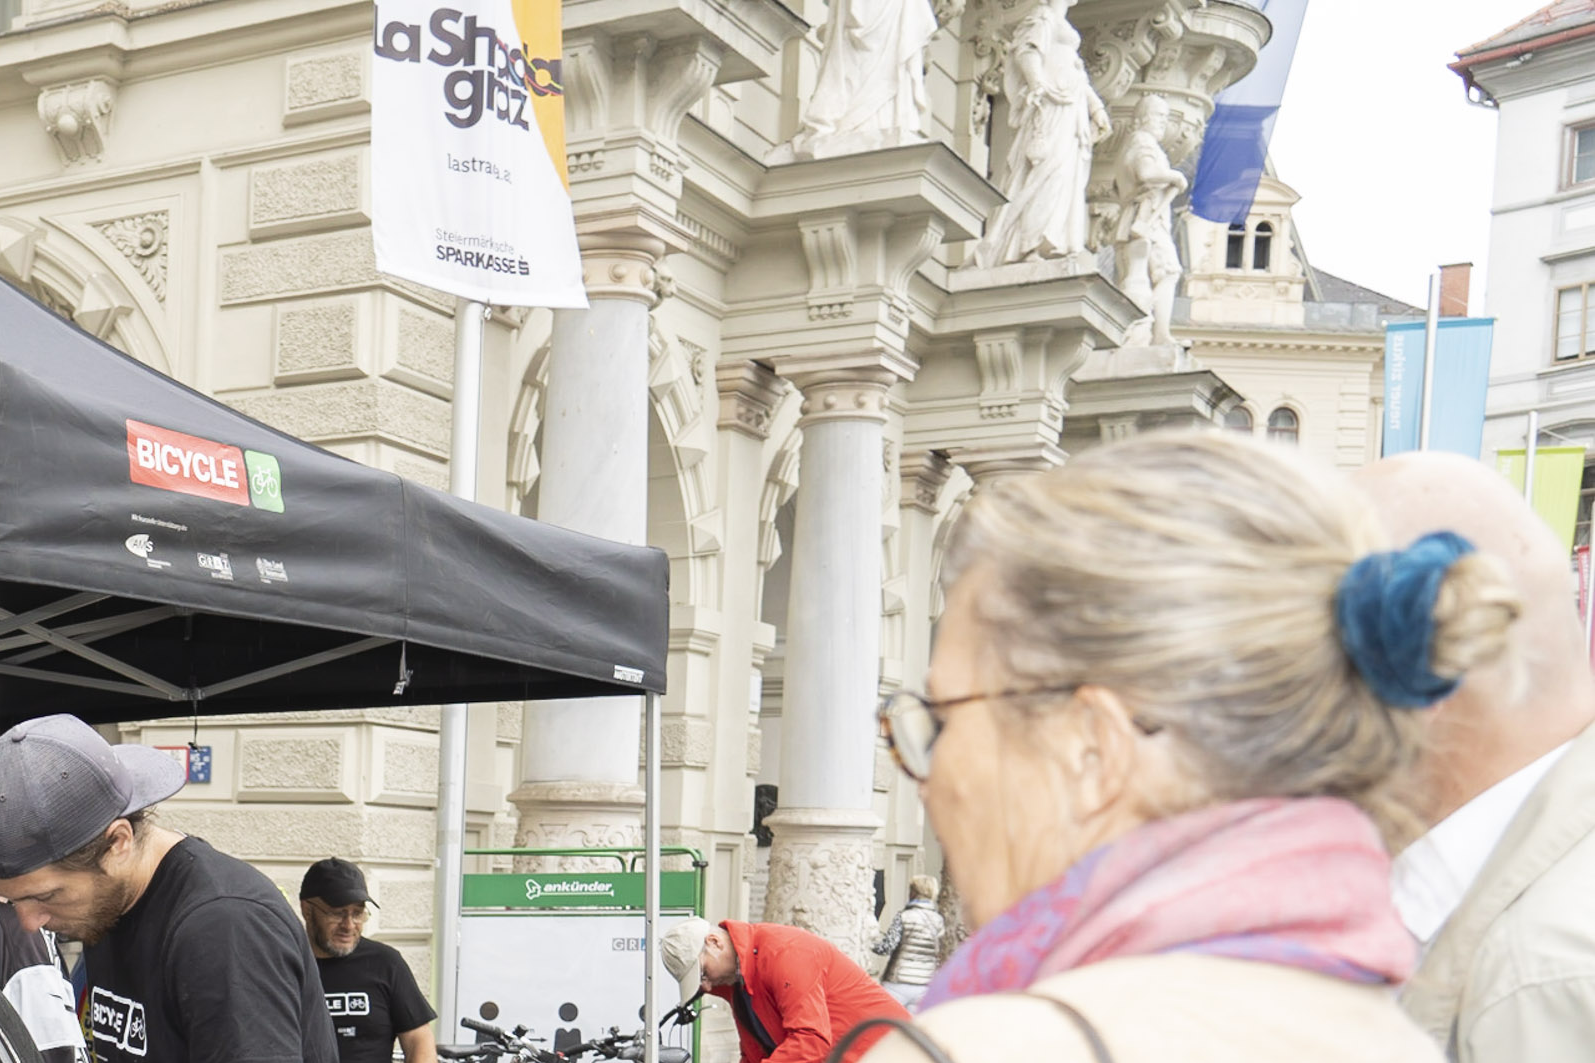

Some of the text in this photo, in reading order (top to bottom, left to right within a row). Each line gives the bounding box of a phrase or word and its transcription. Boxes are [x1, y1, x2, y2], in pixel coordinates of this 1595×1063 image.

[436, 244, 517, 274] SPARKASSE
[136, 437, 240, 490] BICYCLE
[543, 881, 613, 892] ankünder
